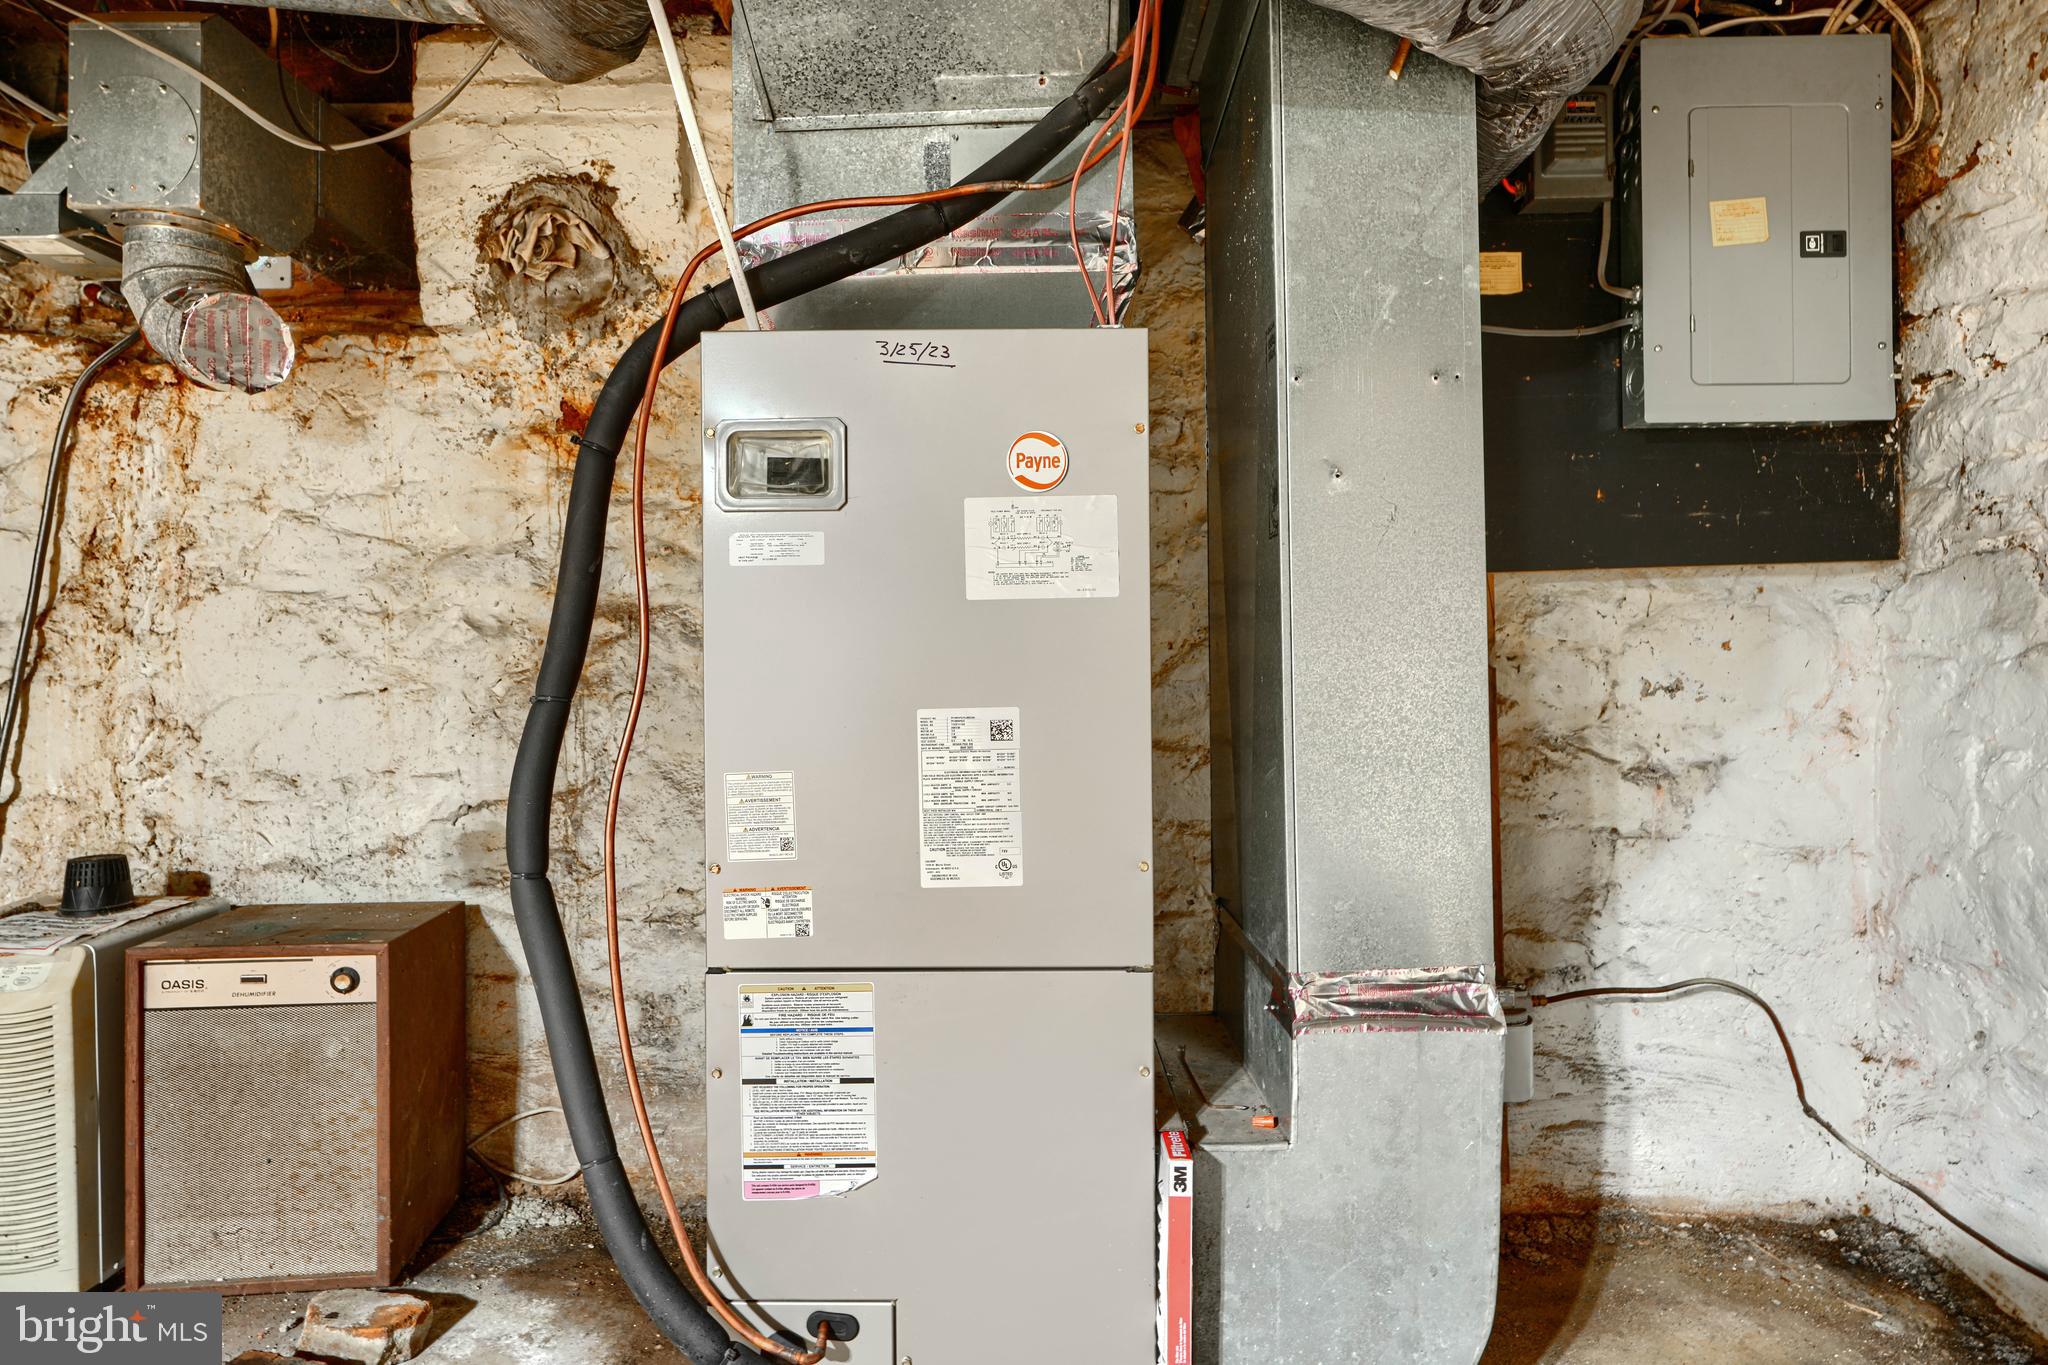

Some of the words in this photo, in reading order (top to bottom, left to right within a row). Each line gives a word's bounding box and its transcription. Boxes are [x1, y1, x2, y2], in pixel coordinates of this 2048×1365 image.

[876, 341, 951, 361] 3/25/23
[1016, 452, 1061, 473] Payne
[161, 979, 205, 990] OASIS
[231, 990, 276, 998] DEHUMIDIFIER
[1173, 1166, 1187, 1192] 3M
